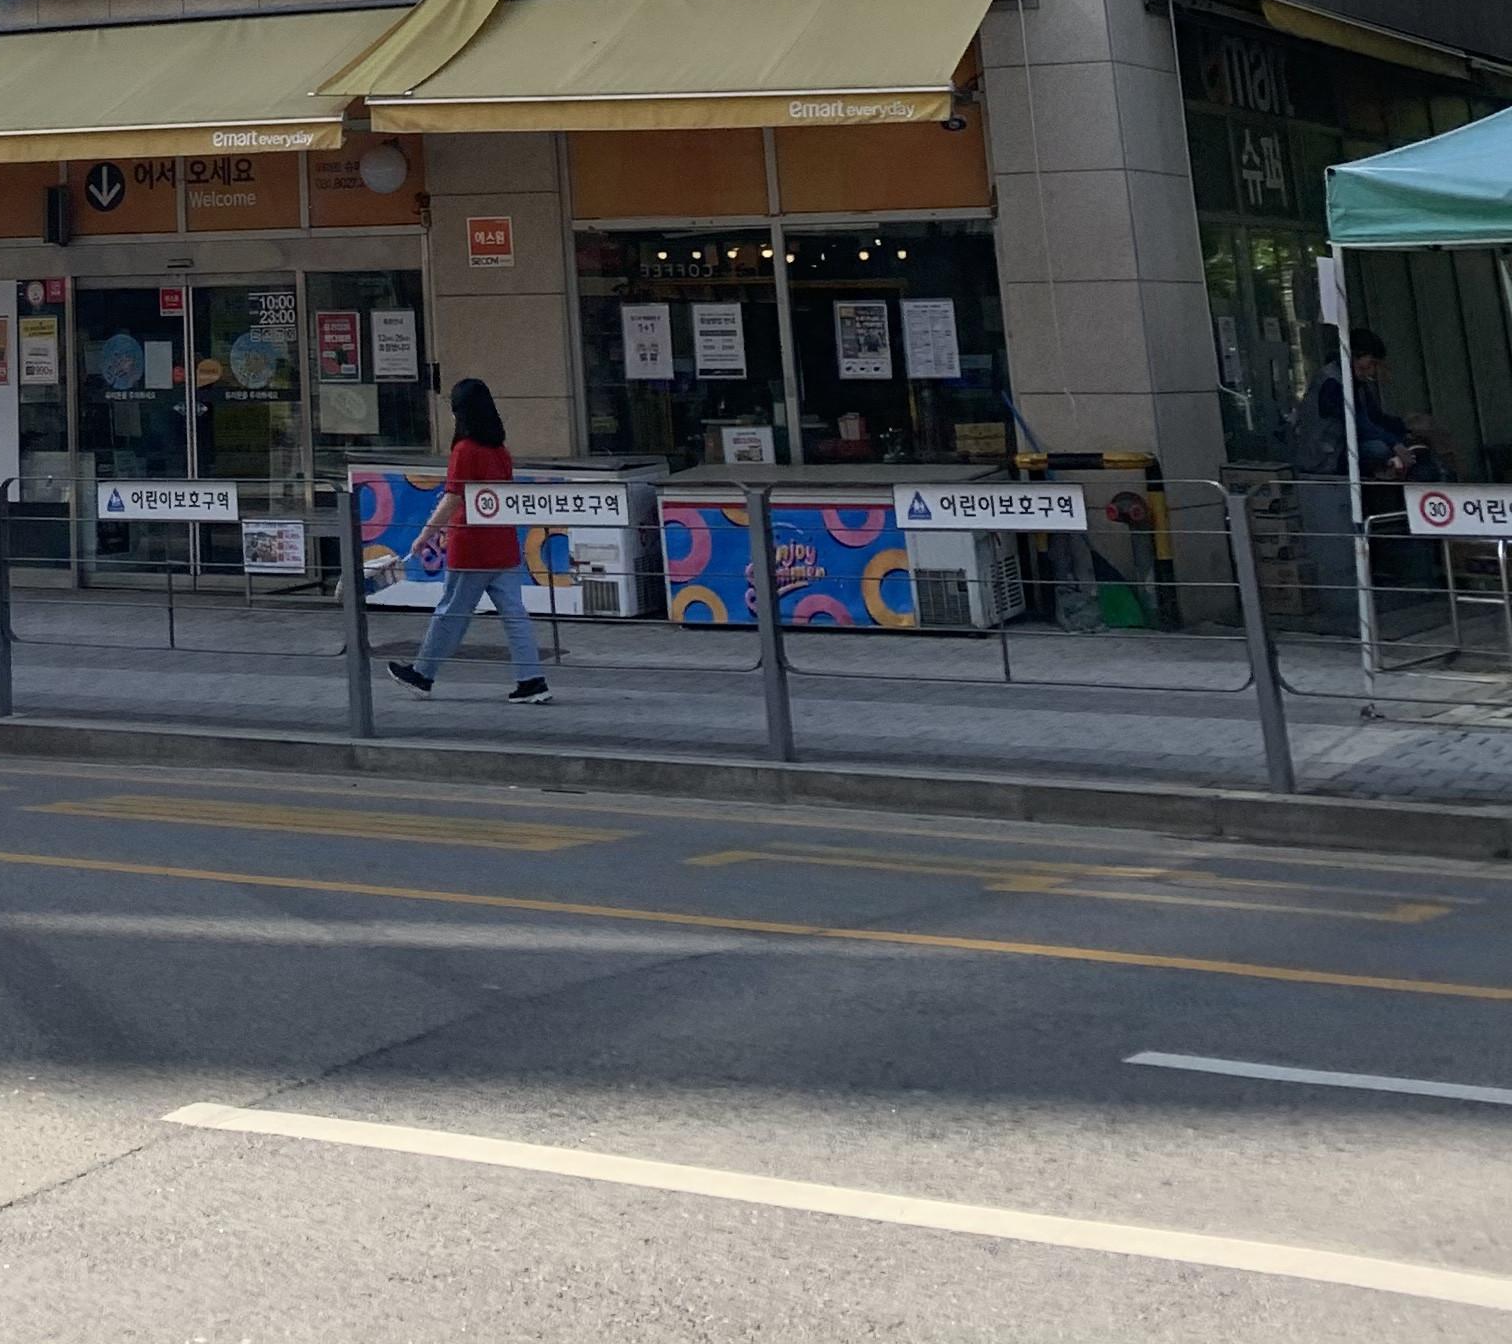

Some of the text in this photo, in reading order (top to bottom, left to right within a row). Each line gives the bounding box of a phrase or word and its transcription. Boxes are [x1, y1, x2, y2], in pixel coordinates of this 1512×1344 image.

[788, 99, 915, 119] emart everyday
[212, 130, 314, 148] emart everyday
[133, 157, 256, 190] 어서 오세요
[188, 190, 257, 209] Welcome
[474, 229, 506, 247] 에스원
[258, 295, 295, 311] 10:00
[258, 310, 296, 325] 23:00
[130, 490, 230, 512] 어린이보호구역
[504, 493, 620, 516] 어린이보호구역
[940, 493, 1074, 519] 어린이보호구역
[1462, 498, 1512, 524] 어린
